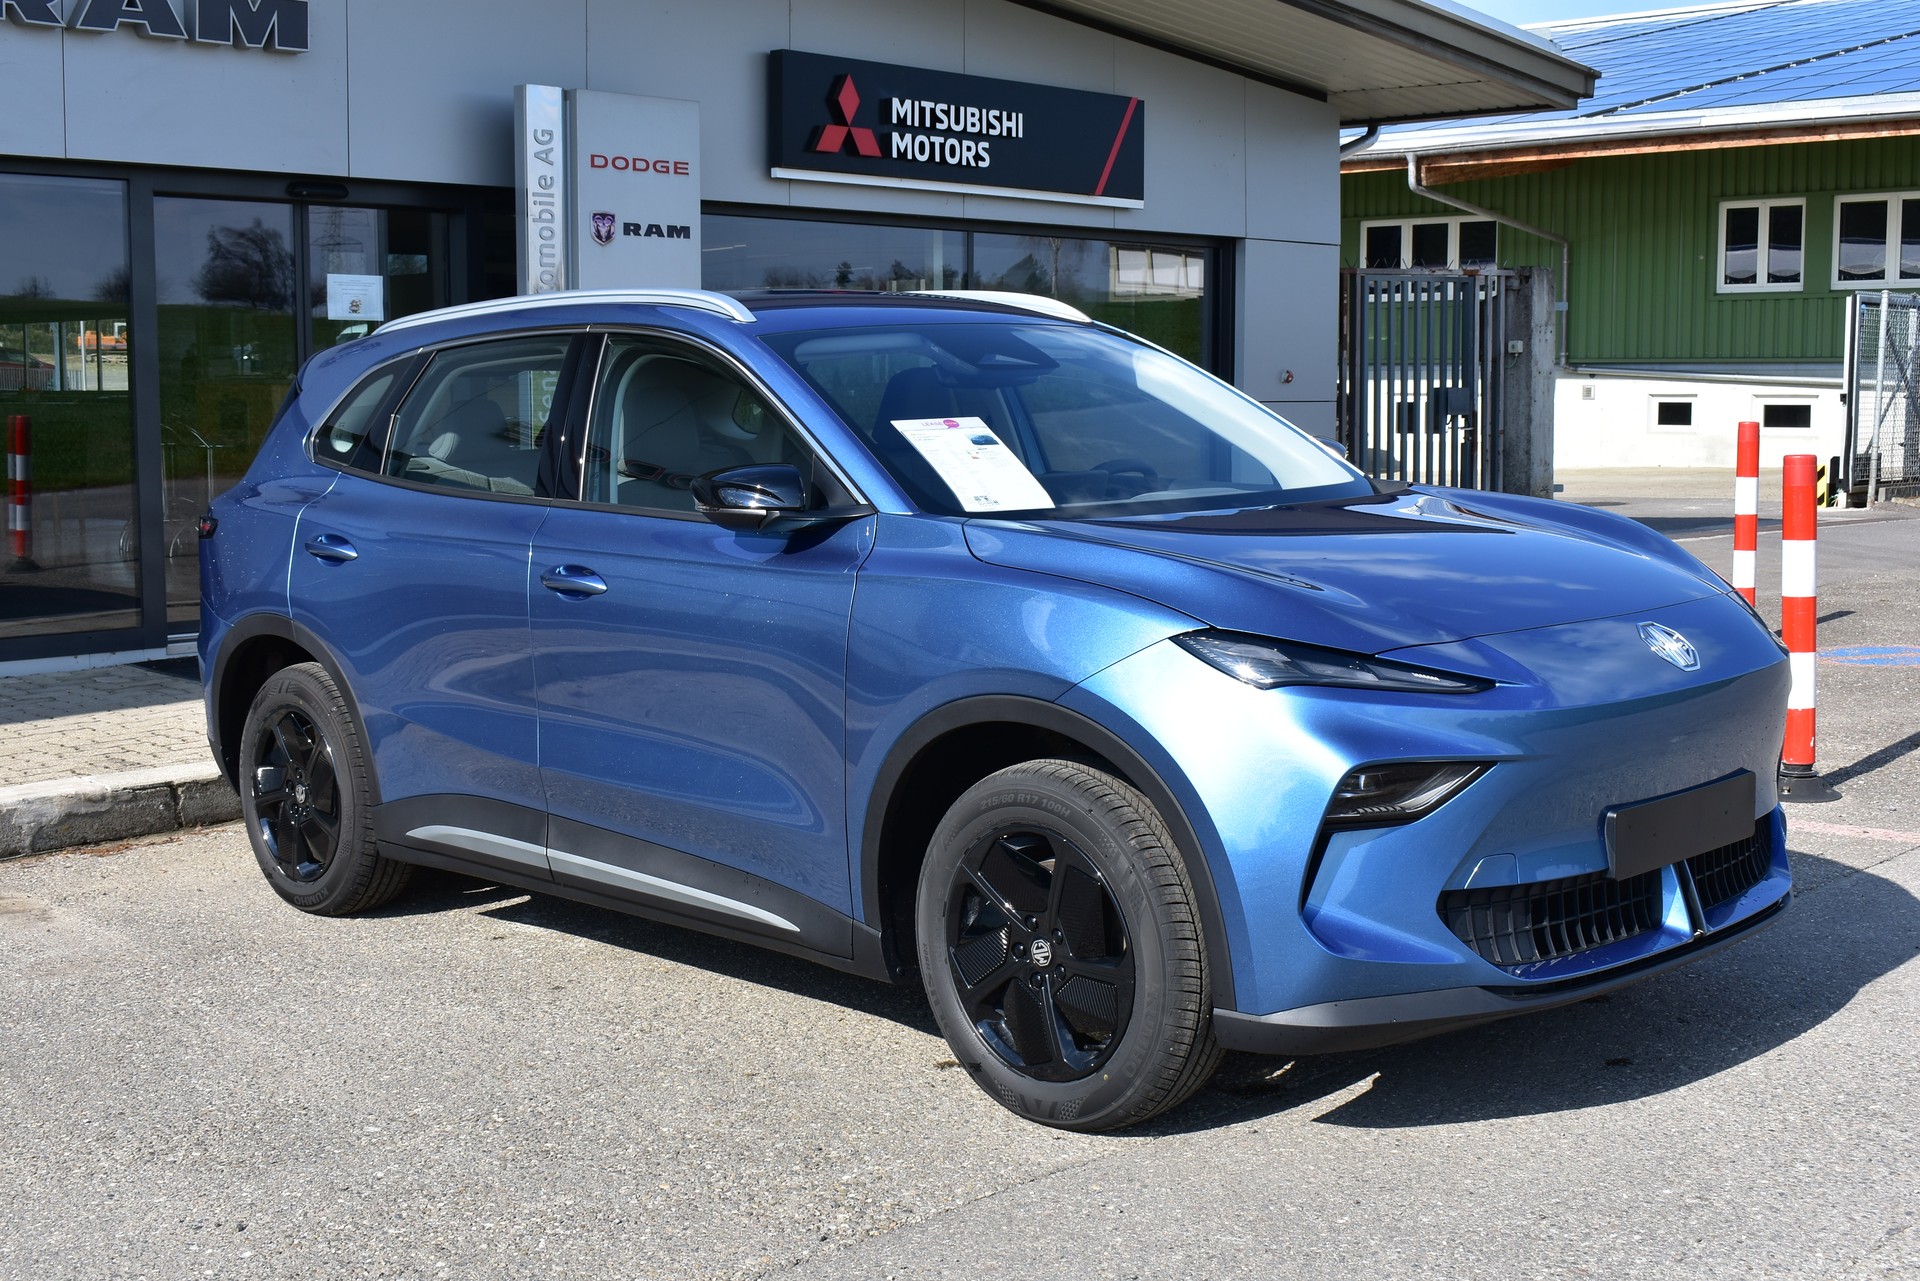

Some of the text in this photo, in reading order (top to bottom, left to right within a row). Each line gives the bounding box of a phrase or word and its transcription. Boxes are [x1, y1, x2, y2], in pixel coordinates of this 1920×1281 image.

[891, 97, 1024, 138] MITSUBISHI
[533, 128, 555, 166] AG
[891, 131, 991, 168] MOTORS
[590, 153, 690, 176] DODGE
[622, 222, 691, 240] RAM
[980, 793, 1071, 818] 215/60 R17 100H
[293, 887, 329, 906] KUMHO
